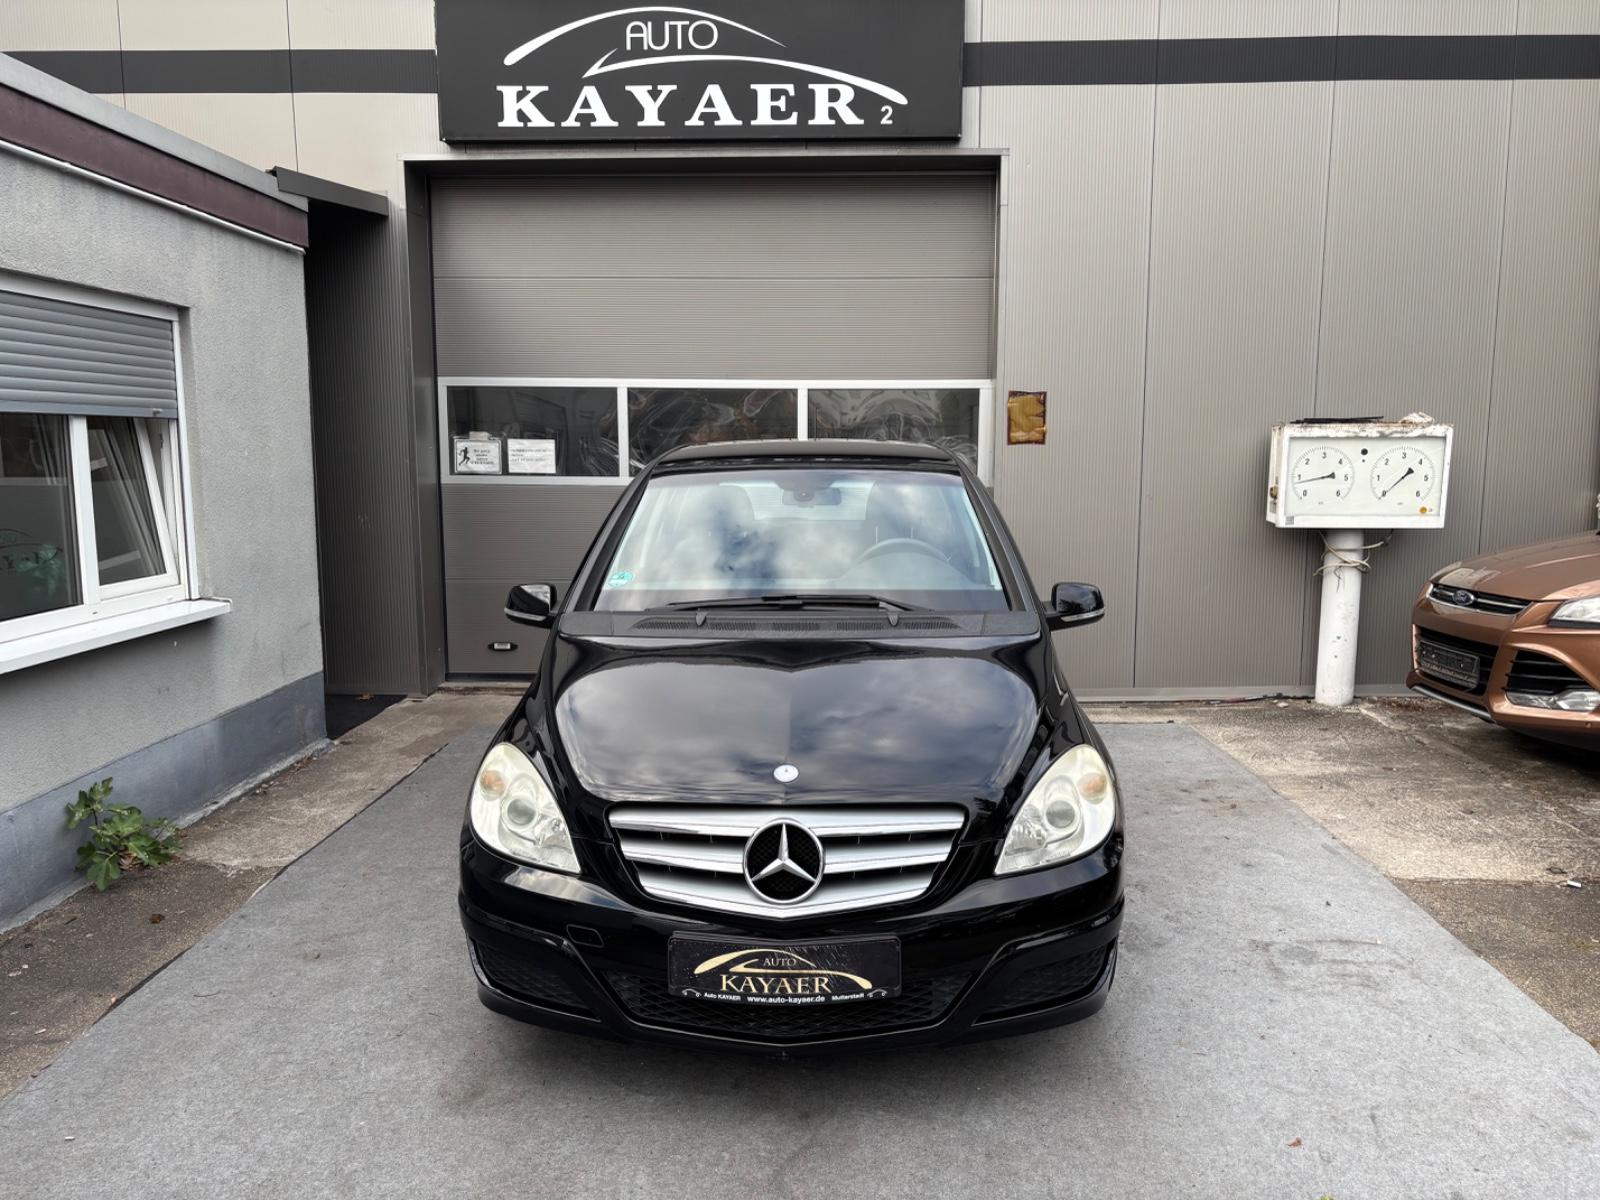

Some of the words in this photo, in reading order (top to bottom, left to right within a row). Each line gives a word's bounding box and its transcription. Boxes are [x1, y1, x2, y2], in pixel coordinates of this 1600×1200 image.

[626, 20, 718, 50] AUTO
[497, 84, 864, 127] KAYAER
[880, 105, 892, 125] 2
[1415, 490, 1421, 498] 6
[763, 958, 797, 966] AUTO
[720, 974, 832, 995] KAYAER
[718, 993, 741, 1001] KAYAER
[747, 995, 825, 1004] www.auto-kayaer.de
